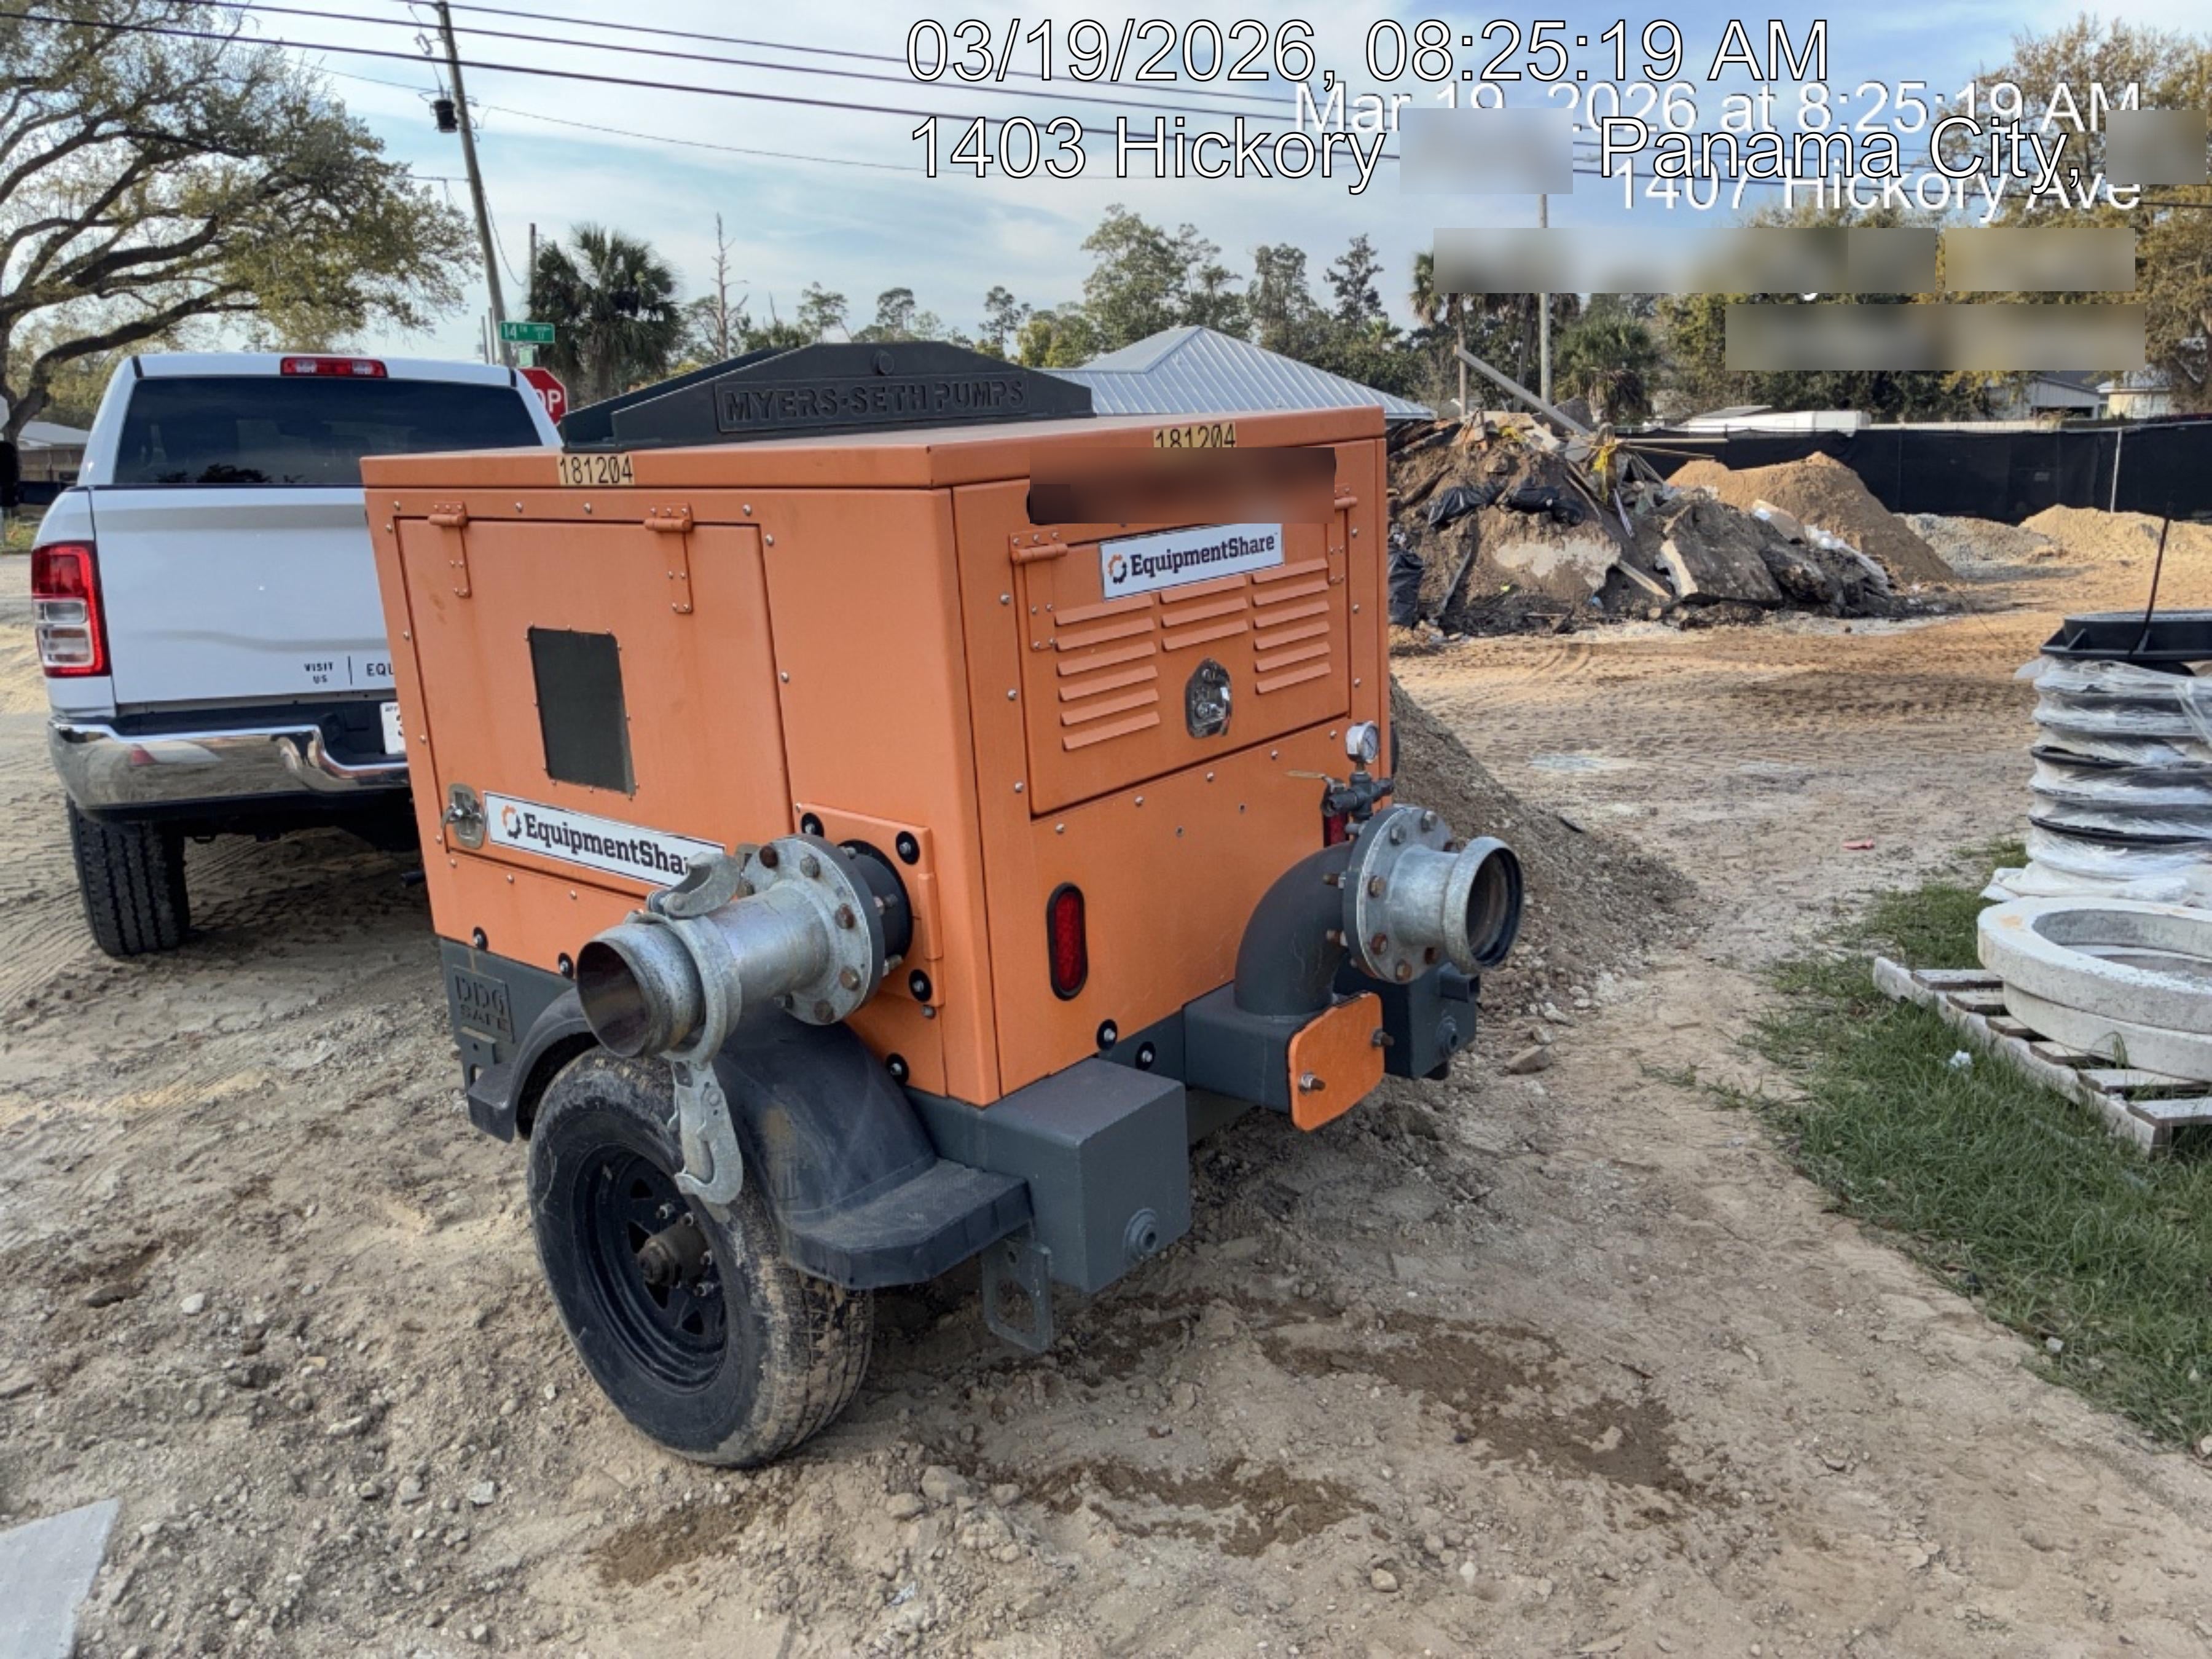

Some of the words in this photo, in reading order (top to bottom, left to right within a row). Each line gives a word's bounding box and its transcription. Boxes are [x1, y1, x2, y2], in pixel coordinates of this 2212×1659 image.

[934, 379, 1024, 412] PUMPS
[560, 455, 633, 484] 181204
[1131, 533, 1275, 578] EquipmentShare
[304, 661, 333, 672] VISIT
[313, 675, 327, 684] US
